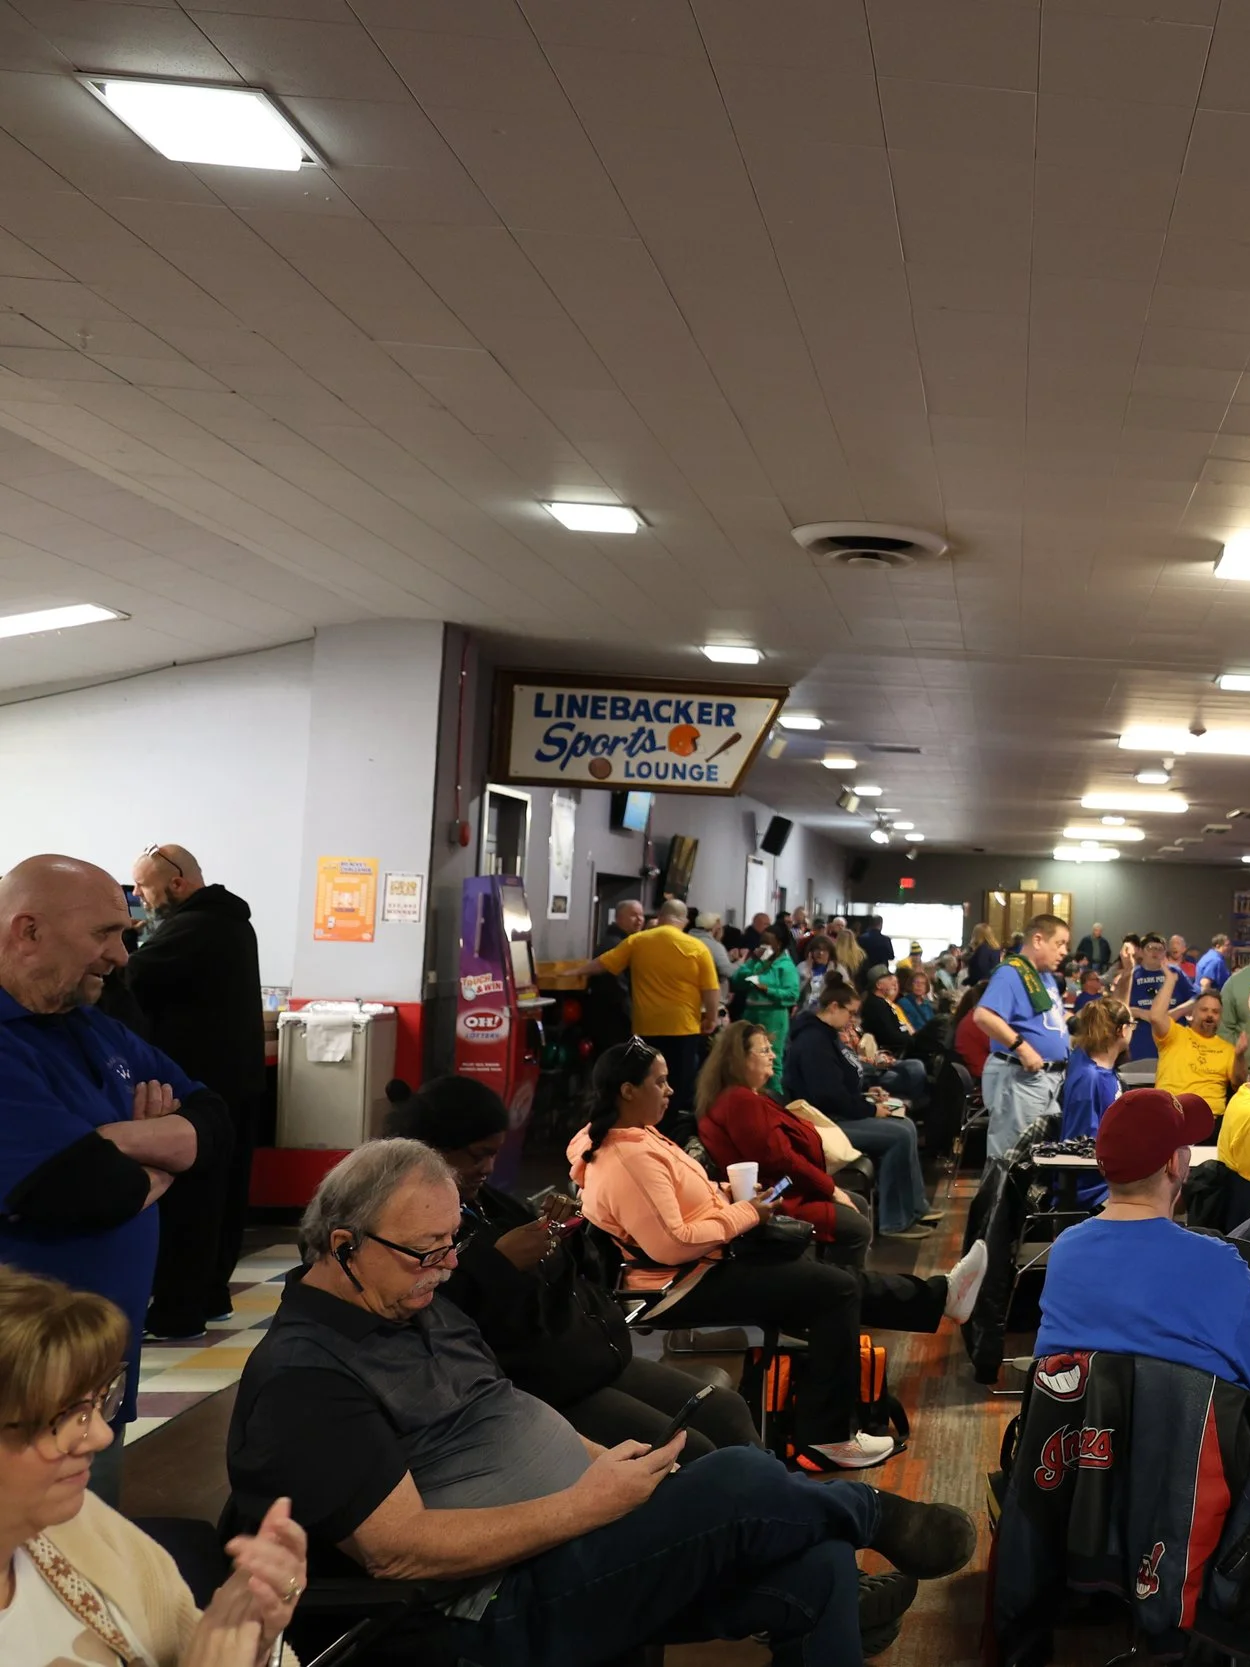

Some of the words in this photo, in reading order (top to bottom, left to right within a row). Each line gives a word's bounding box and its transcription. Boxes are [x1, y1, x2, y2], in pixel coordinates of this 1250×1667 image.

[534, 692, 736, 727] LINEBACKER
[534, 722, 666, 771] Sports
[624, 760, 719, 782] LOUNGE
[485, 981, 501, 991] WIN
[465, 1015, 500, 1027] OH!
